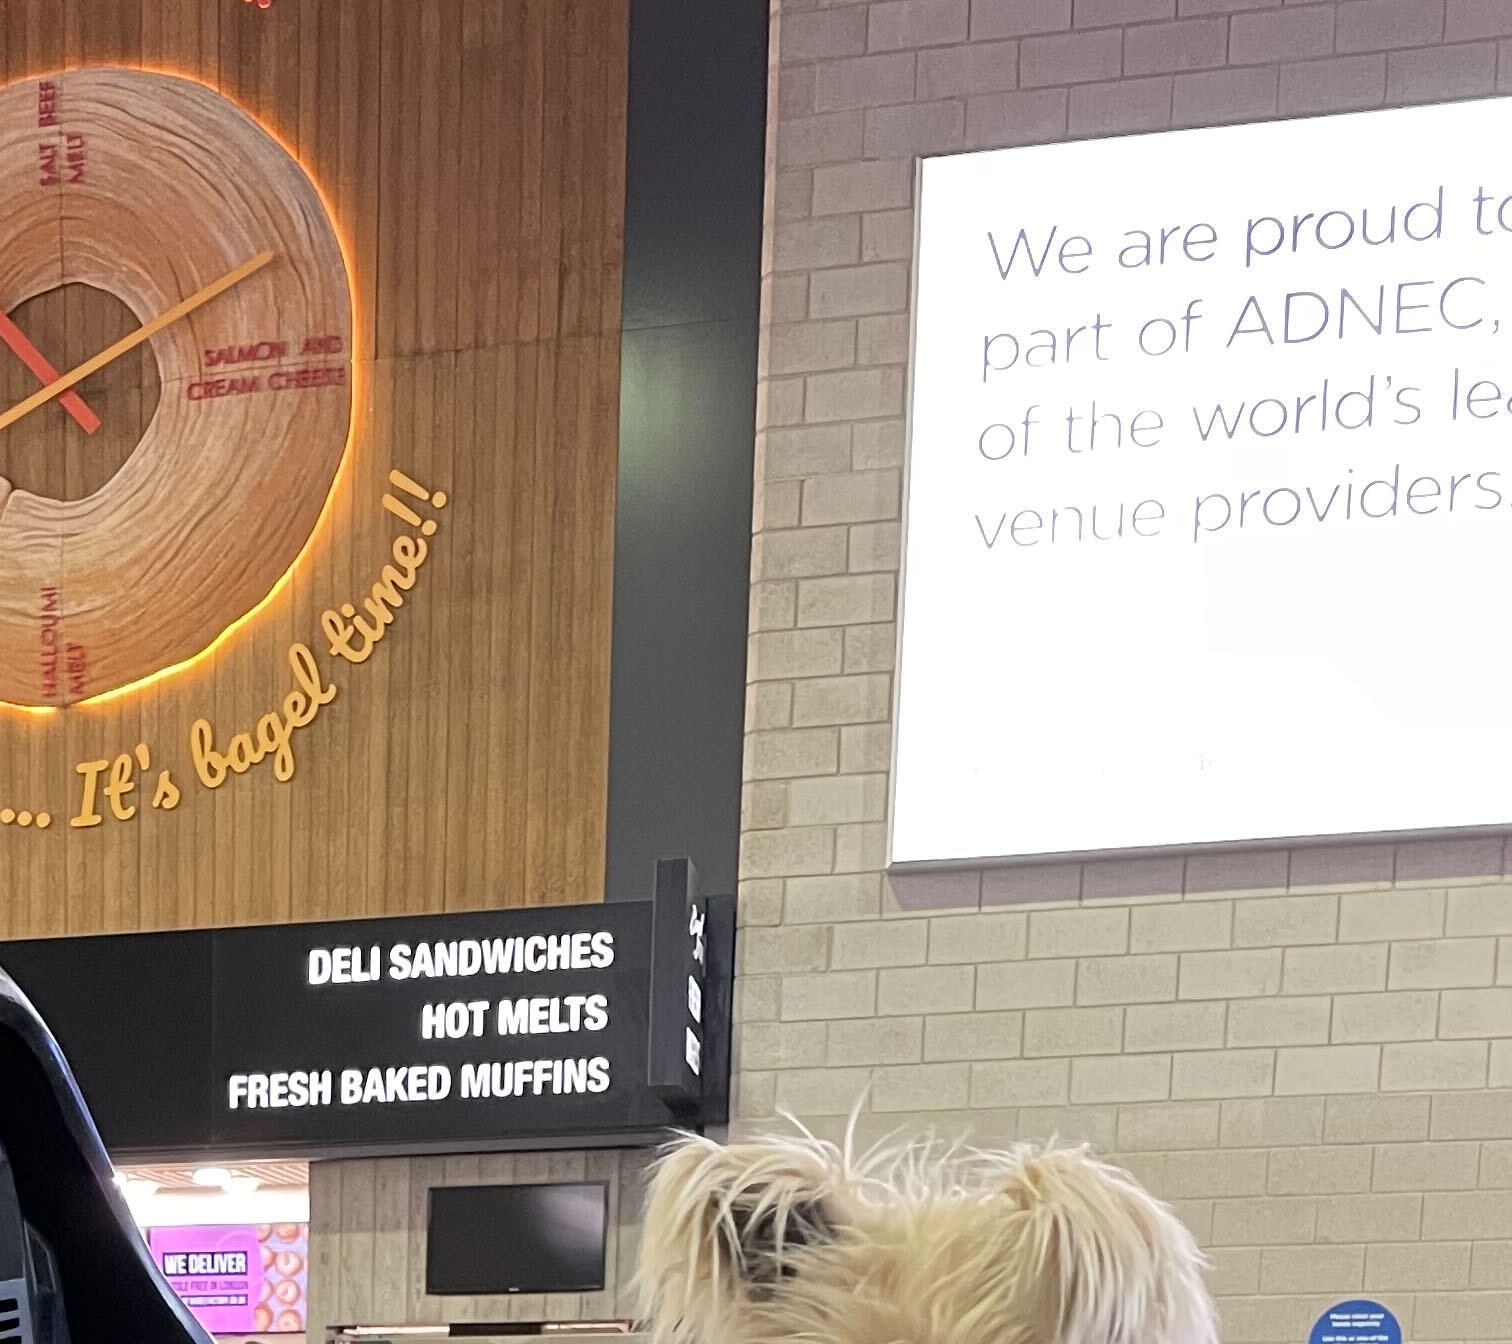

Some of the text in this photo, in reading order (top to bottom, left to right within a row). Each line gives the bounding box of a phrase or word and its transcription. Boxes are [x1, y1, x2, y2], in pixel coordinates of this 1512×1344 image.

[39, 81, 56, 127] BEEF
[66, 131, 86, 184] MELT
[986, 225, 1093, 280] We
[1118, 222, 1218, 269] are
[1246, 185, 1443, 267] proud
[204, 341, 289, 367] SALMON
[983, 276, 1500, 383] part of ADNEC,
[187, 367, 345, 401] CREAM CHEESE
[978, 404, 1040, 460] of
[1065, 400, 1164, 454] the
[974, 463, 1512, 549] venue providers
[39, 586, 58, 697] HALLOUMI
[66, 642, 86, 694] MELT
[70, 743, 182, 828] It's
[191, 642, 337, 789] bagel
[321, 469, 448, 664] time!!
[308, 931, 615, 985] DELI SANDWICHES
[422, 994, 609, 1039] HOT MELTS
[229, 1057, 610, 1109] FRESH BAKED MUFFINS
[164, 1252, 246, 1275] WE DELIVER
